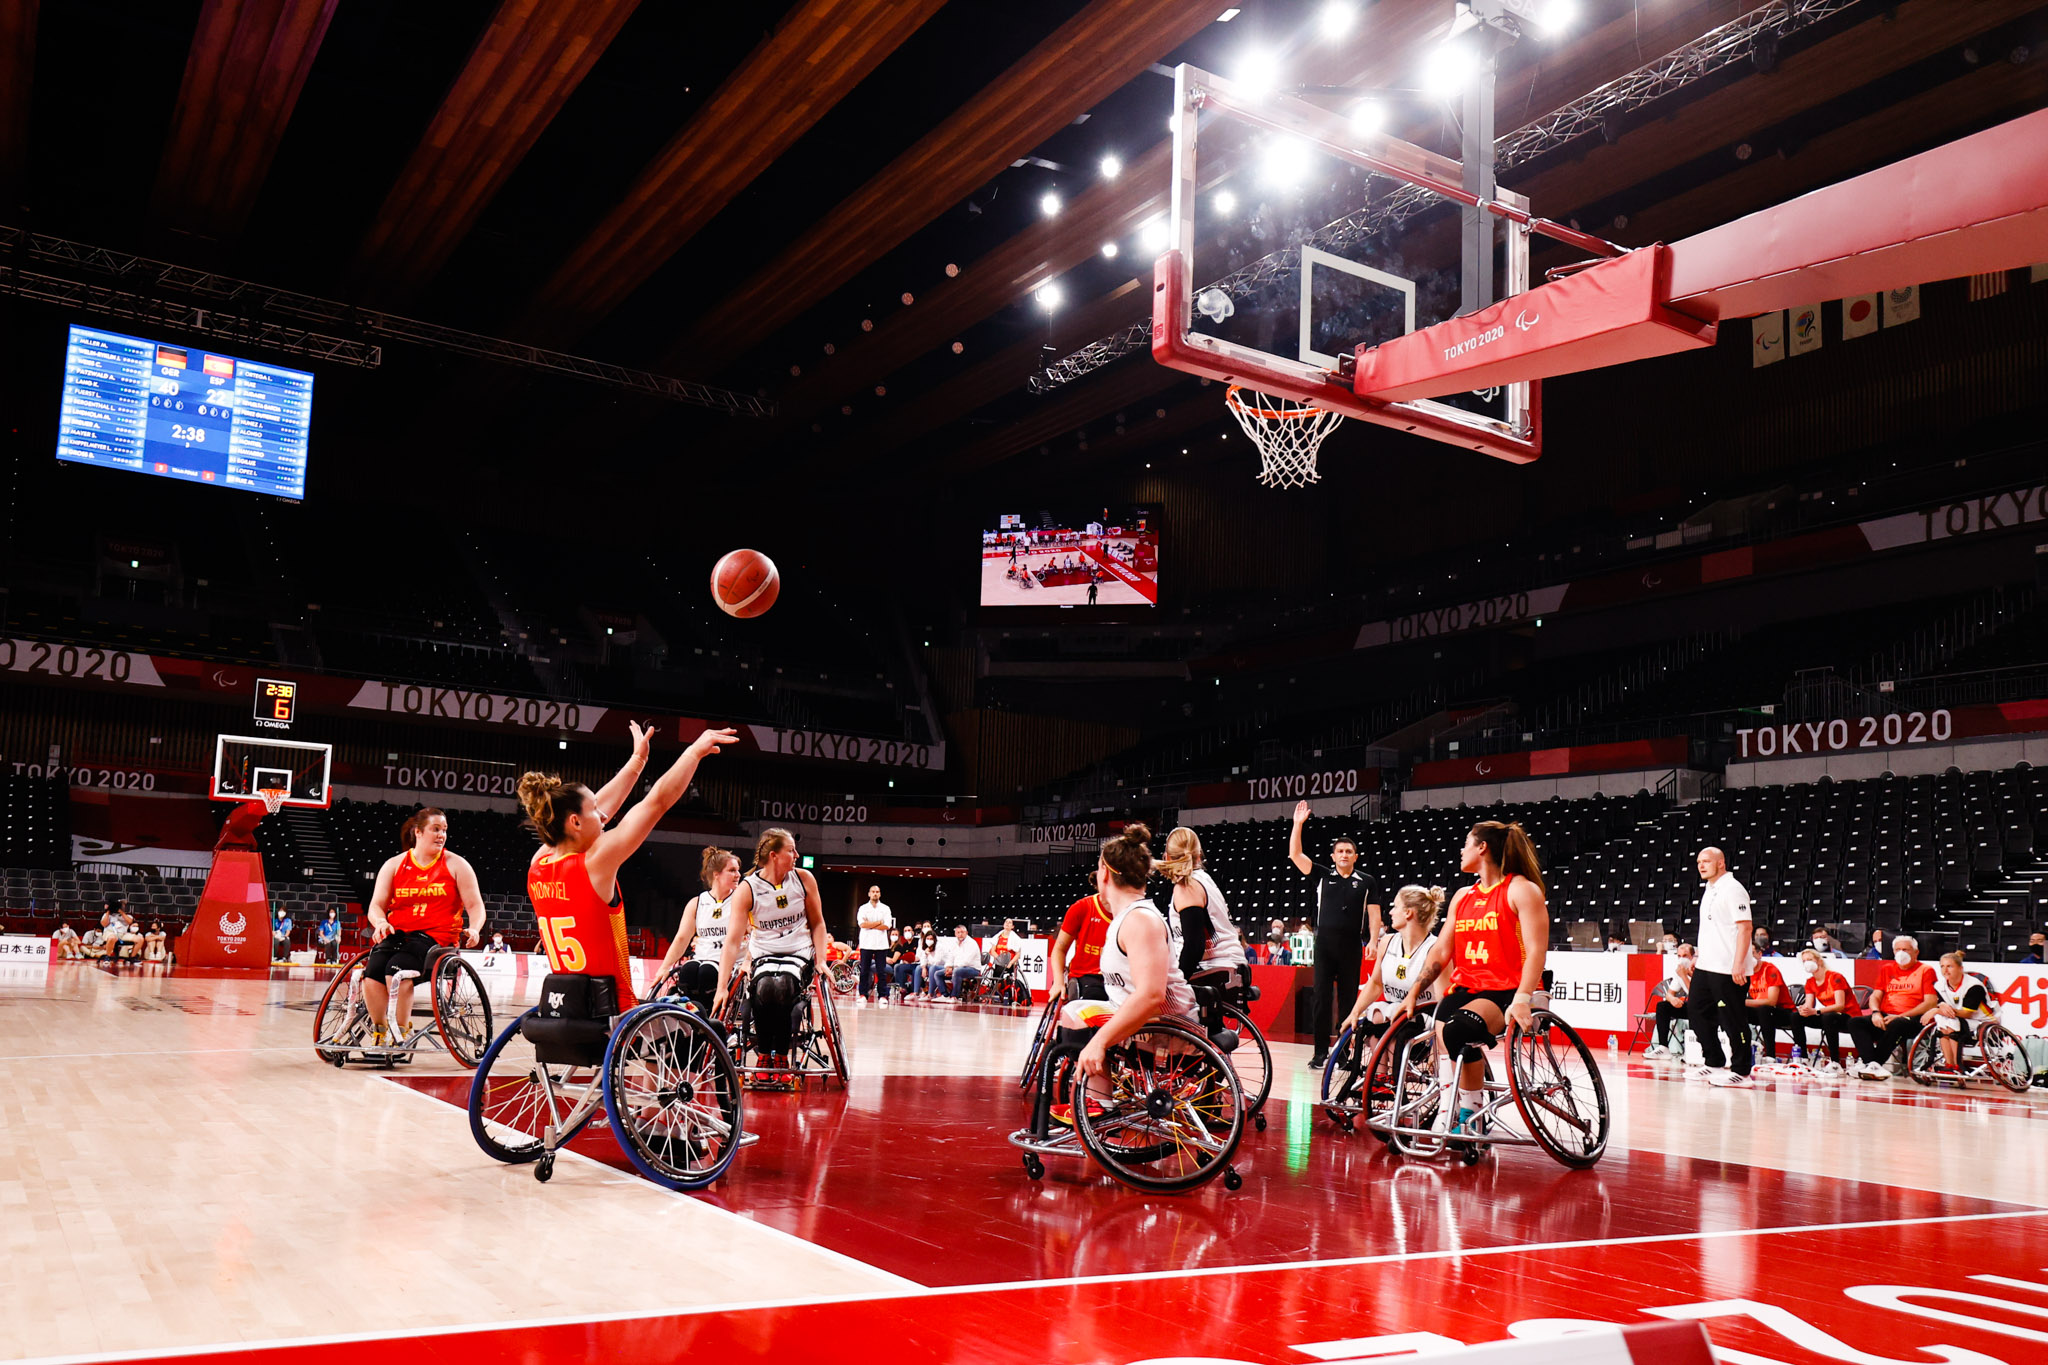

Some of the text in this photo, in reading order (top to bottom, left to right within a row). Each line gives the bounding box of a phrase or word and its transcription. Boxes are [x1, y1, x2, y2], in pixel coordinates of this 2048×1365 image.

[79, 338, 100, 347] MILLER
[1444, 326, 1504, 360] TOKYO 2020
[76, 368, 108, 379] PATZWALD
[161, 367, 180, 377] GER
[209, 376, 226, 386] ESP
[158, 382, 180, 396] 40
[206, 389, 225, 405] 22
[70, 430, 92, 438] MAYER
[172, 424, 205, 442] 2:38
[240, 430, 262, 438] ALONSO
[1386, 592, 1528, 643] TOKYO 2020
[28, 642, 131, 682] 2020
[266, 683, 293, 698] 2:38
[274, 698, 290, 720] 6
[382, 682, 579, 730] TOKYO 2020
[263, 720, 290, 730] OMEGA
[1736, 708, 1952, 758] TOKYO 2020
[773, 728, 928, 769] TOKYO 2020
[98, 770, 155, 791] 2020
[383, 766, 516, 795] TOKYO 2020
[1248, 769, 1358, 800] TOKYO 2020
[760, 800, 867, 823] TOKYO 2020
[1030, 822, 1096, 842] TOKYO 2020
[396, 882, 447, 898] ESPAÑA
[530, 881, 570, 900] MONTIEL
[0, 944, 46, 954] 日本生命
[538, 916, 586, 972] 15
[1465, 941, 1489, 964] 44
